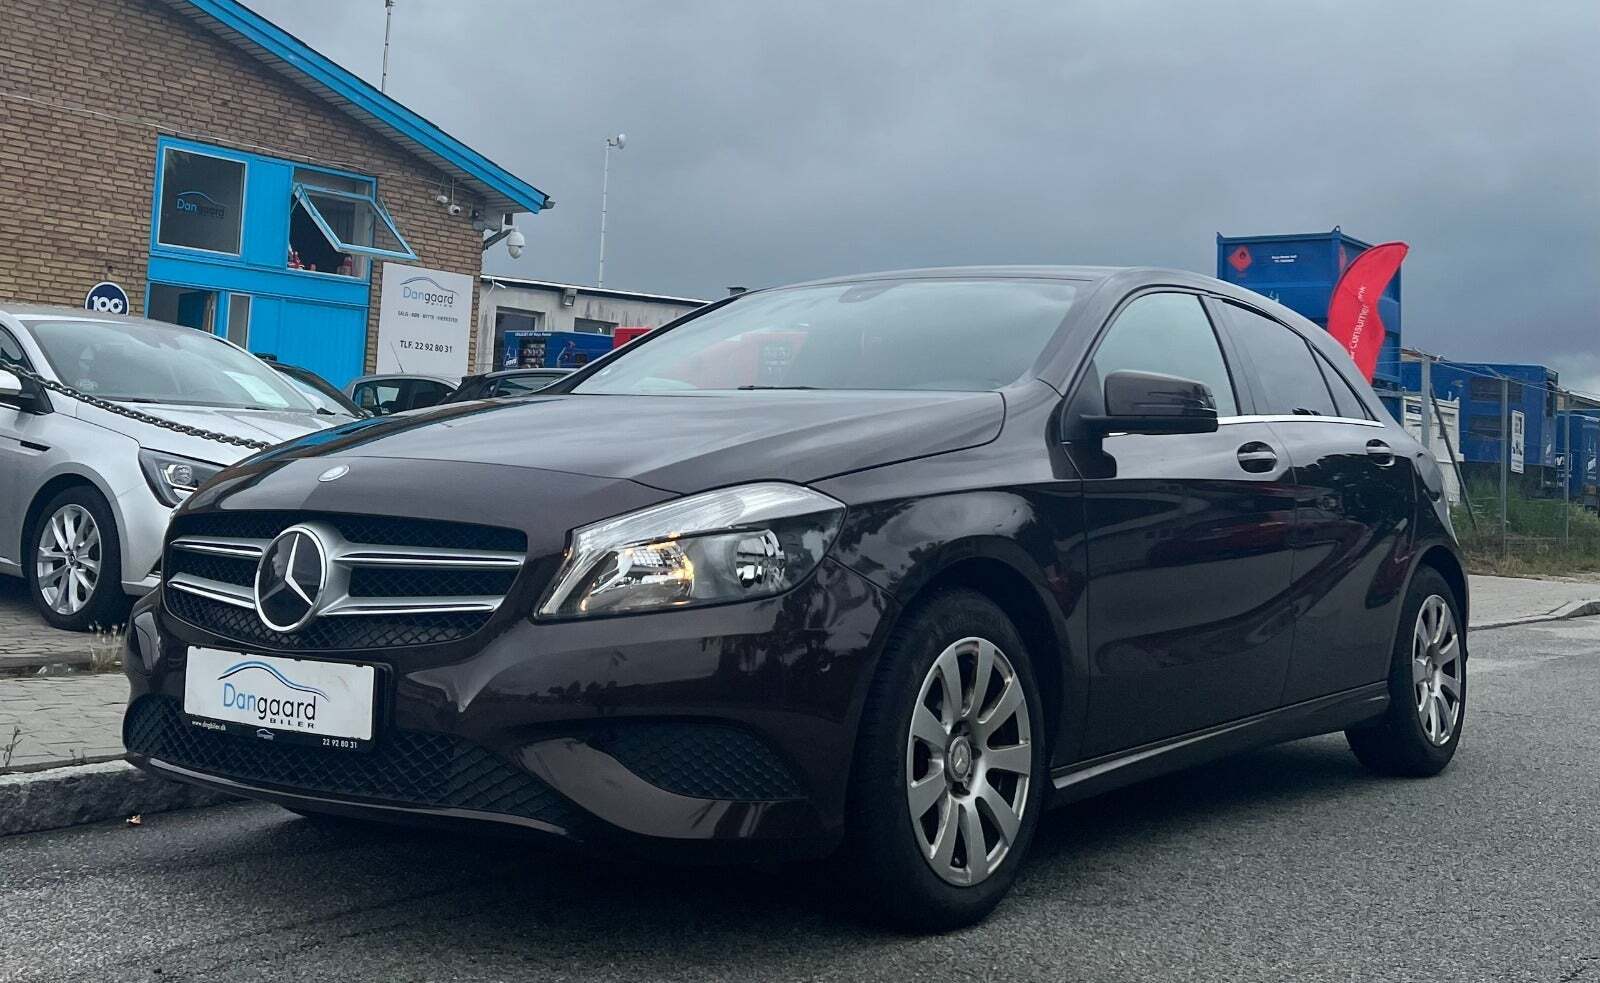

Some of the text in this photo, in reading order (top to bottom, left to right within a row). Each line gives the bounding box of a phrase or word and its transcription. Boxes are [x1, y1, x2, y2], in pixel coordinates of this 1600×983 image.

[176, 198, 226, 219] Danrd
[403, 286, 454, 305] Dangaard
[414, 341, 424, 350] 22
[425, 342, 433, 352] 92
[434, 344, 444, 353] 80
[444, 345, 453, 353] 31
[223, 682, 317, 721] Dangaard
[269, 717, 315, 729] BILER
[322, 738, 358, 749] 22 92 80 31
